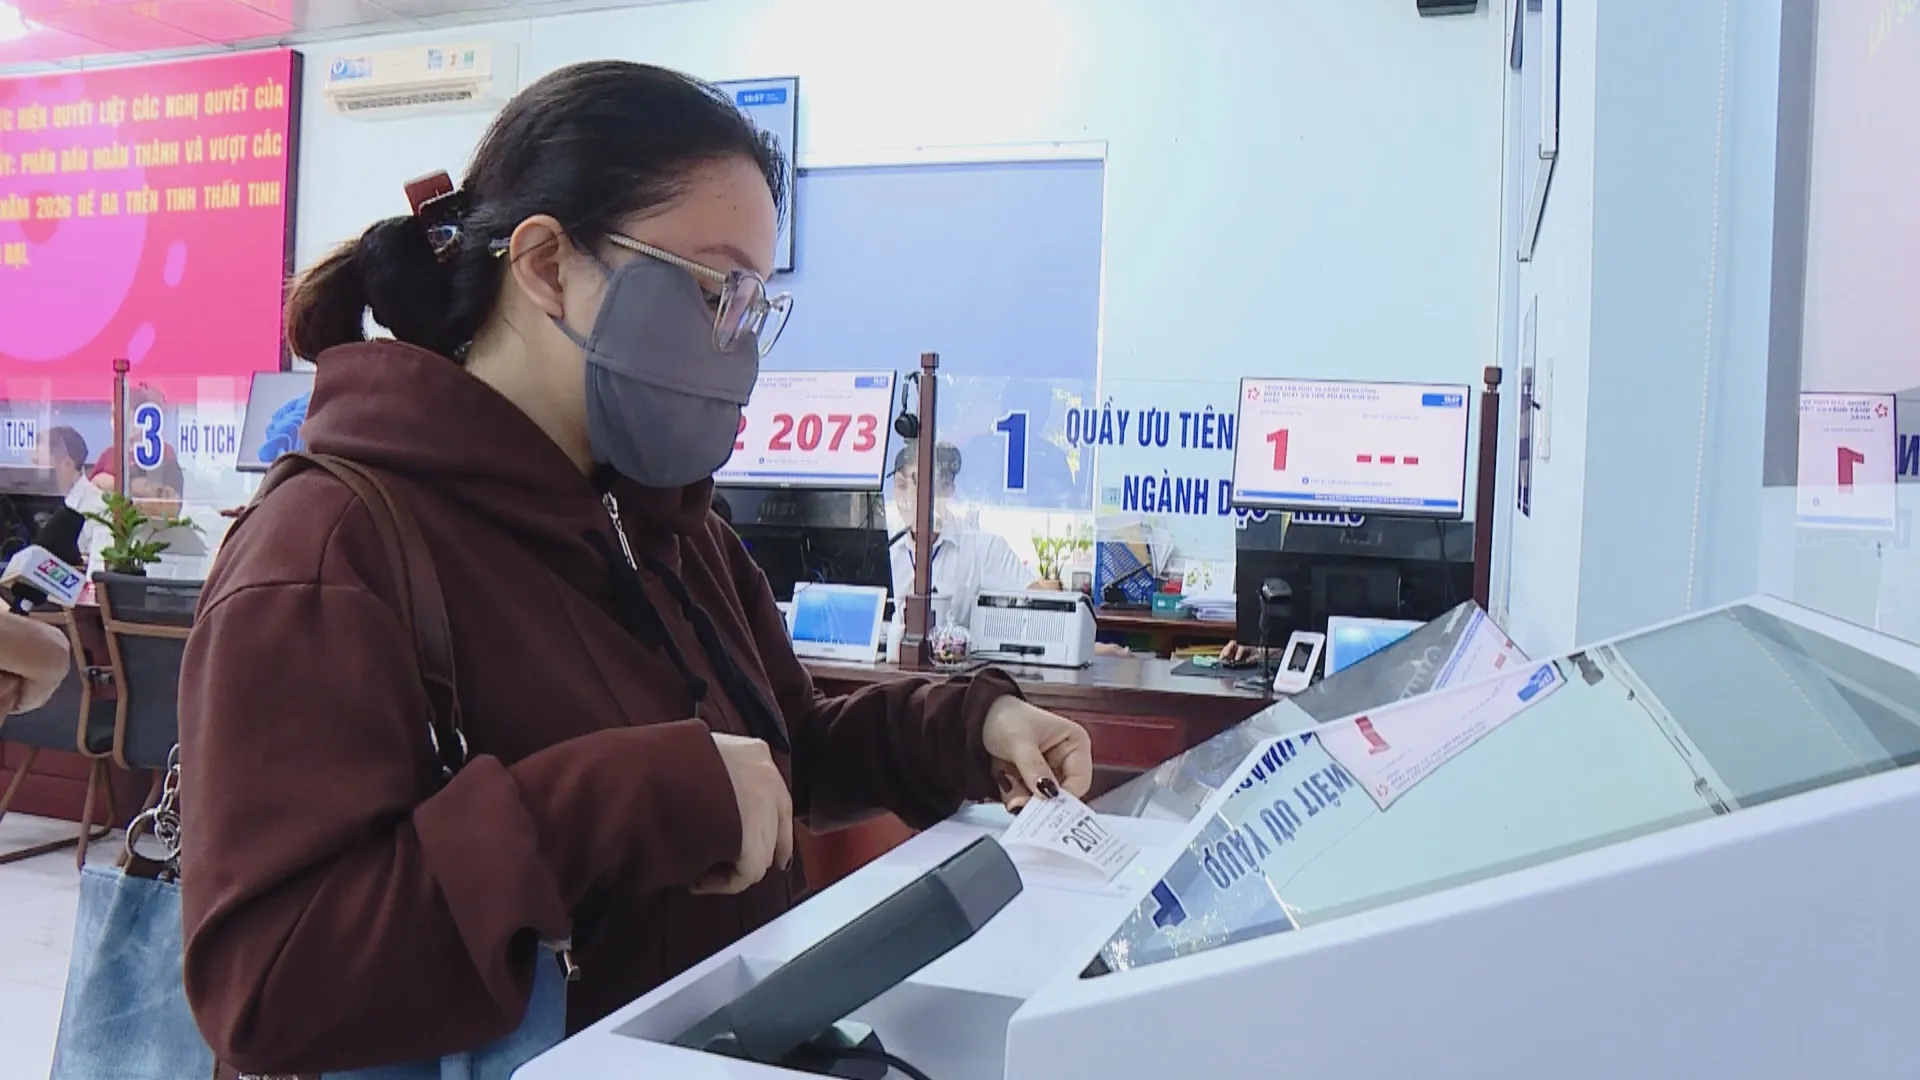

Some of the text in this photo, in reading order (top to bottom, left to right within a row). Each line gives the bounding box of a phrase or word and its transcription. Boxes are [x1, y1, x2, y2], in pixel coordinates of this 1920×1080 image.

[133, 92, 160, 121] CÁC
[165, 92, 199, 120] NGHỊ
[205, 81, 248, 115] QUYẾT
[255, 77, 284, 110] CỦA
[134, 137, 179, 167] THÀNH
[185, 135, 203, 164] VÀ
[210, 134, 248, 165] VƯỢT
[253, 128, 283, 158] CÁC
[35, 195, 72, 219] 2026
[165, 187, 197, 212] TINH
[248, 181, 281, 206] TINH
[6, 421, 34, 455] TỊCH
[136, 406, 162, 467] 3
[180, 418, 235, 460] HỘ TỊCH
[768, 413, 878, 452] 2073
[1066, 396, 1234, 449] QUẦY ƯU TIÊN
[996, 412, 1027, 490] 1
[1267, 428, 1289, 471] 1
[1122, 468, 1209, 515] NGÀNH
[1062, 815, 1108, 853] 2077
